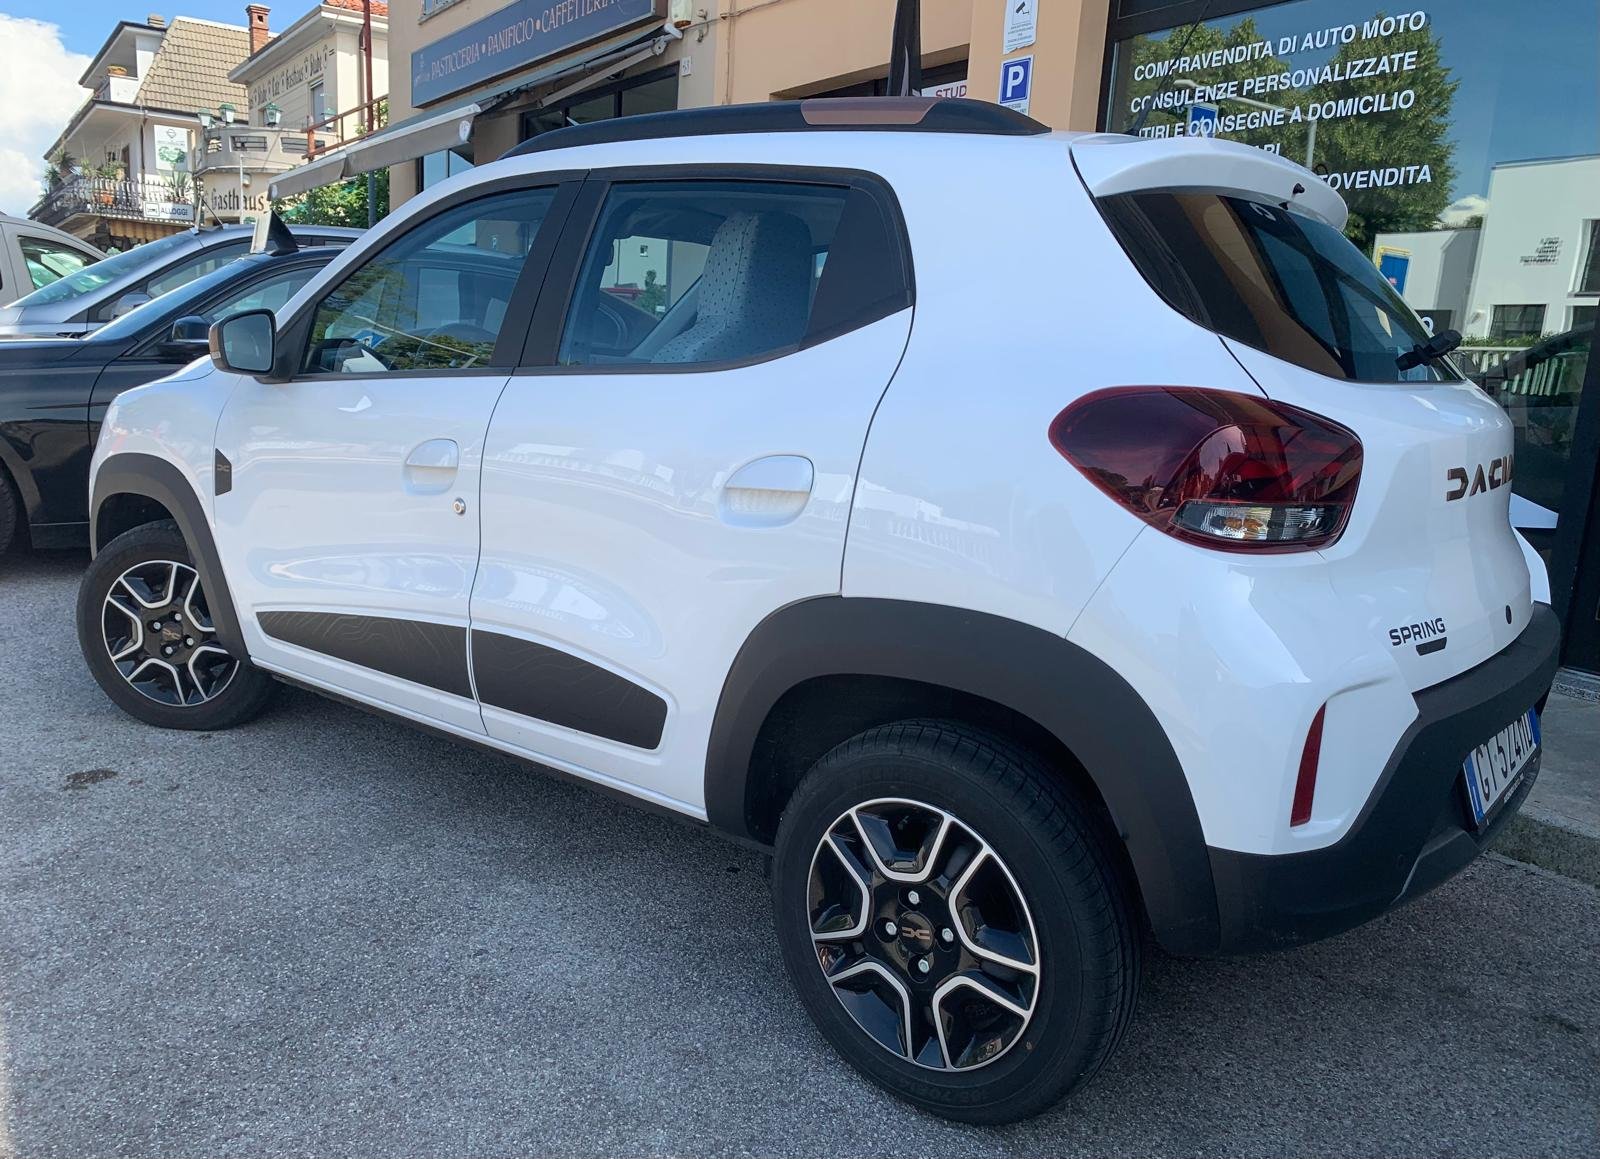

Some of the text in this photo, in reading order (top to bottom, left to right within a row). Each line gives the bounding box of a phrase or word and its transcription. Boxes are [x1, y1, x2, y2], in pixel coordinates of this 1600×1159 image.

[431, 42, 480, 80] PASTICCERIA
[487, 17, 534, 57] PANIFICIO
[541, 0, 619, 33] CAFFETTE
[1134, 10, 1426, 81] COMPRAVENDITA DI AUTO MOTO
[1006, 65, 1025, 98] P
[1242, 51, 1418, 96] PERSONALIZZATE
[1188, 107, 1286, 137] CONSEGNE
[1289, 106, 1302, 124] A
[1307, 89, 1415, 121] DOMICILIO
[160, 207, 188, 216] ALLOGGI
[211, 187, 265, 211] Gasthaus
[1389, 617, 1446, 647] SPRING
